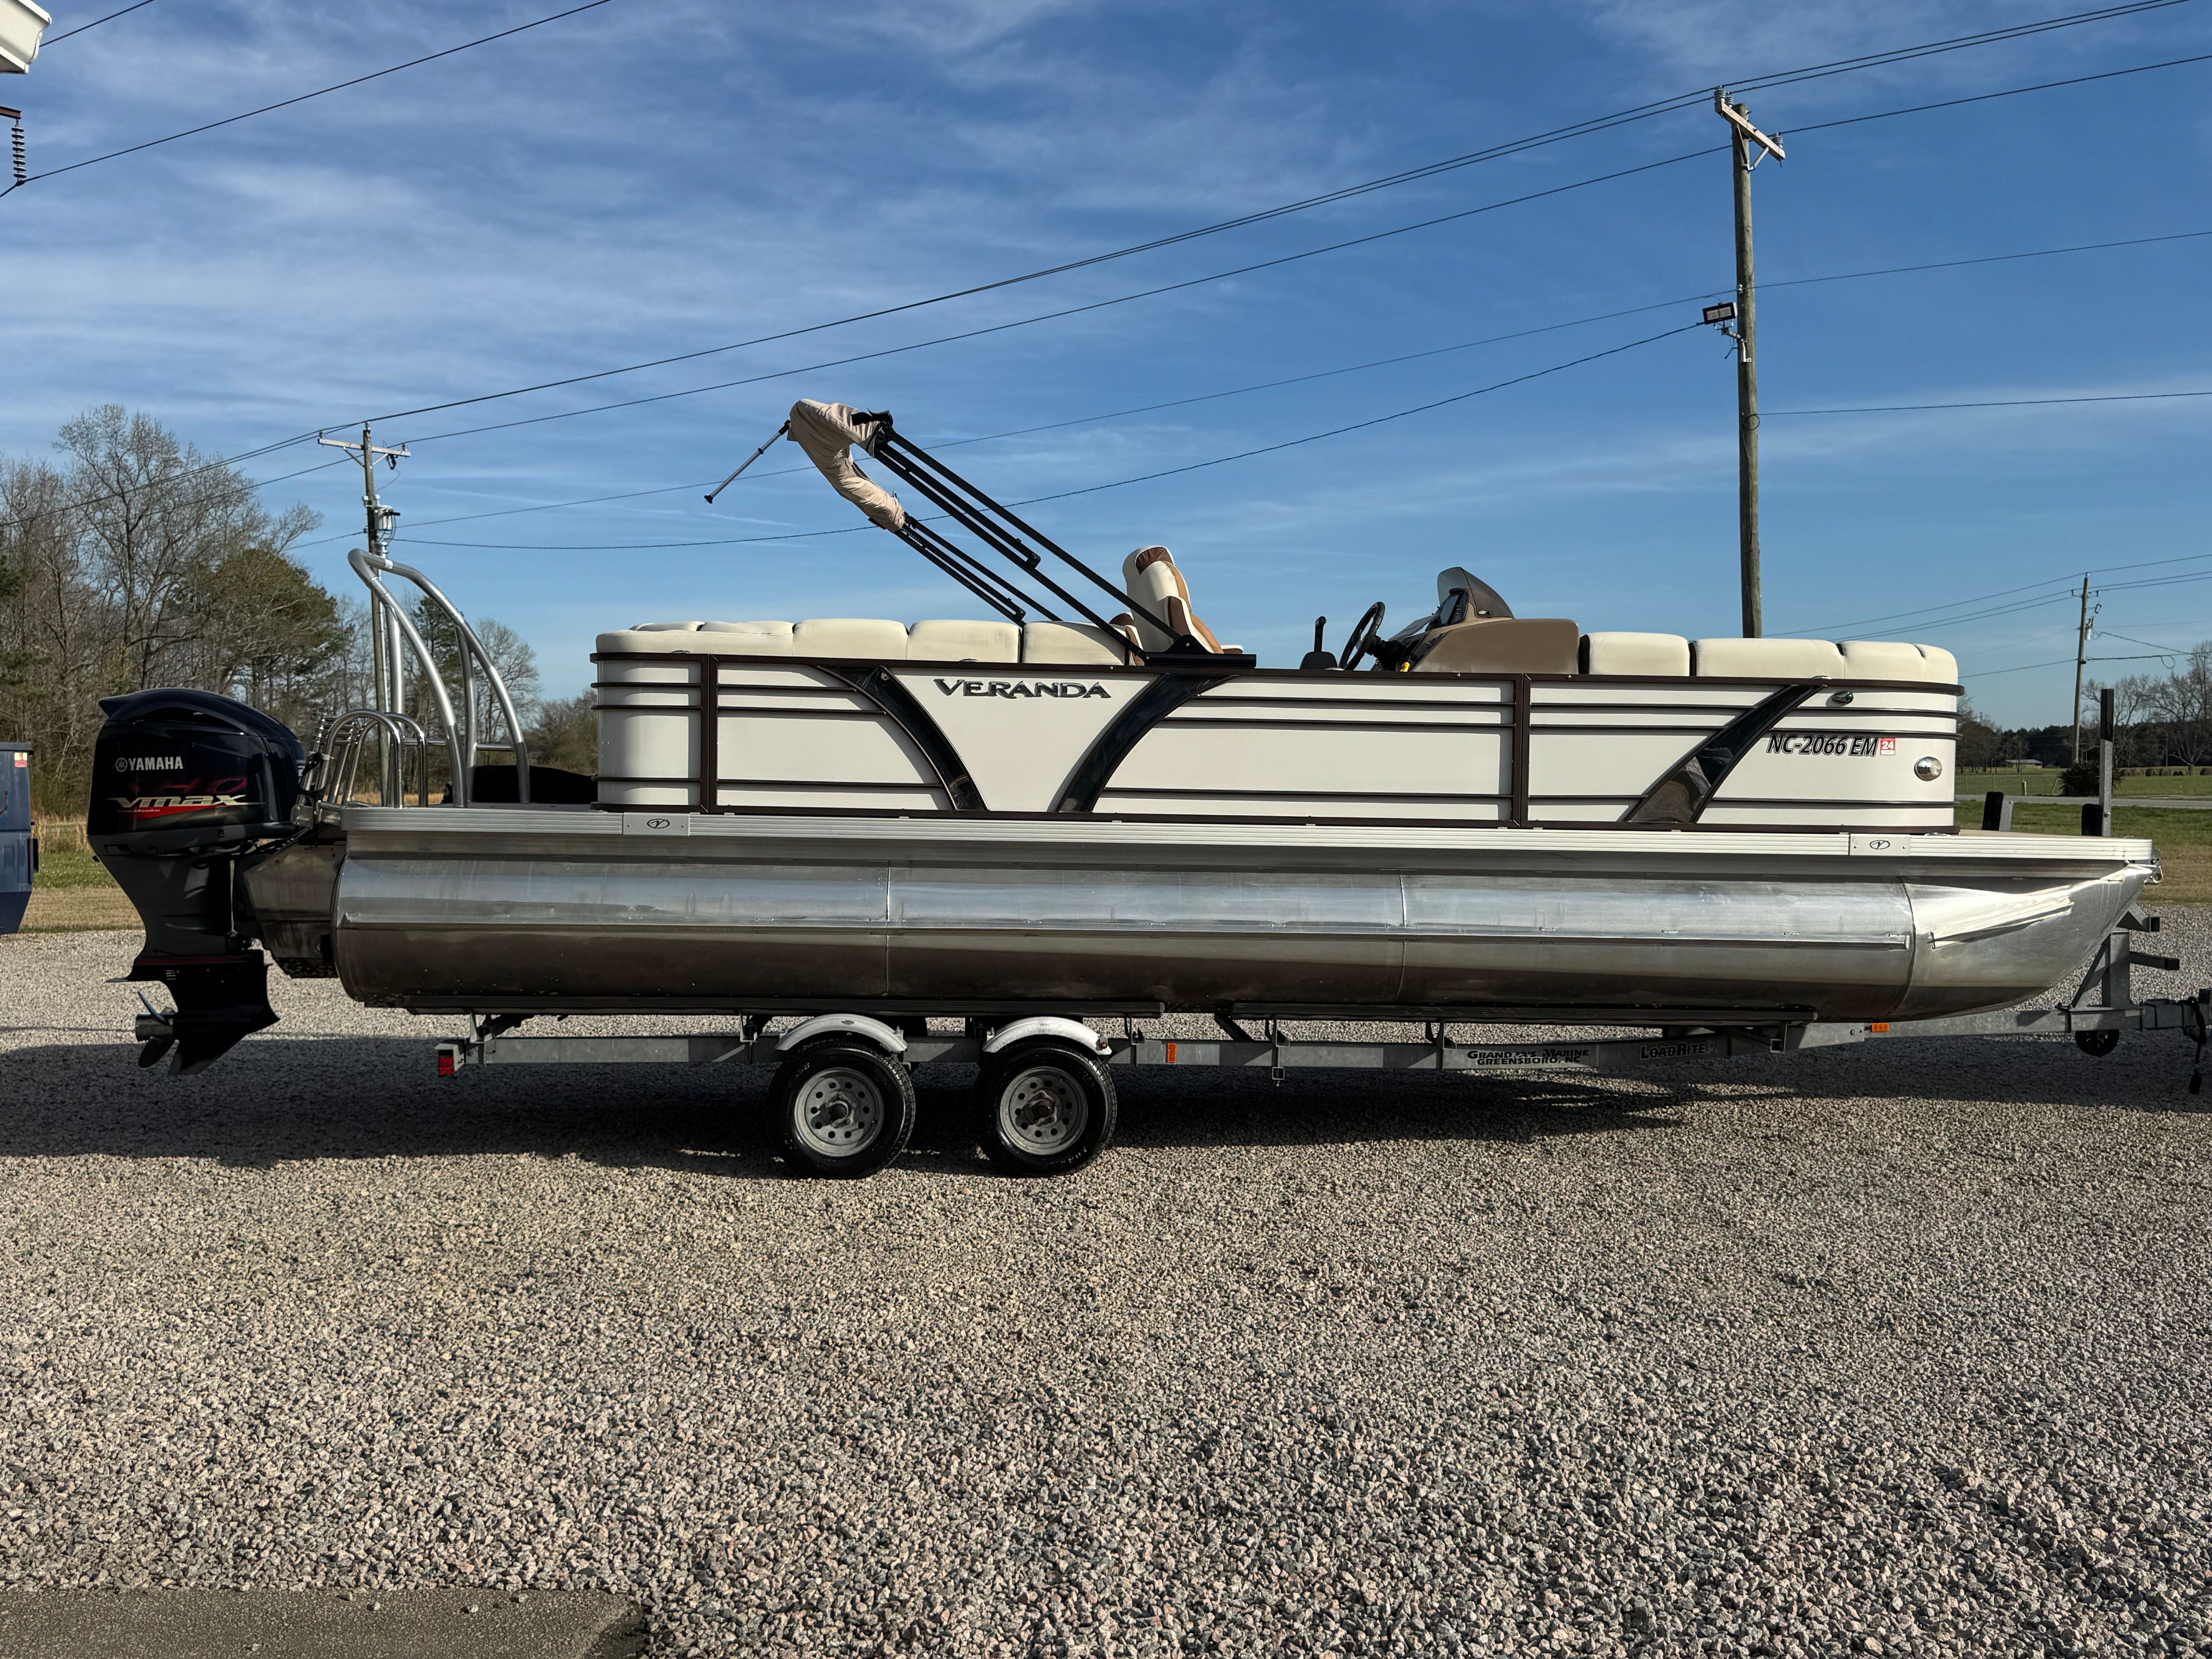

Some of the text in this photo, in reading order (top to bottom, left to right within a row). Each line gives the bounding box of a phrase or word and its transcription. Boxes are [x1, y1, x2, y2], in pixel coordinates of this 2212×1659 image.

[933, 678, 1111, 699] VERANDA
[1766, 733, 1879, 757] NC-2066 EM
[1882, 740, 1894, 750] 24
[128, 756, 184, 771] YAMAHA
[1542, 1049, 1589, 1057] MARINE
[1477, 1057, 1561, 1065] GREENSBORO,
